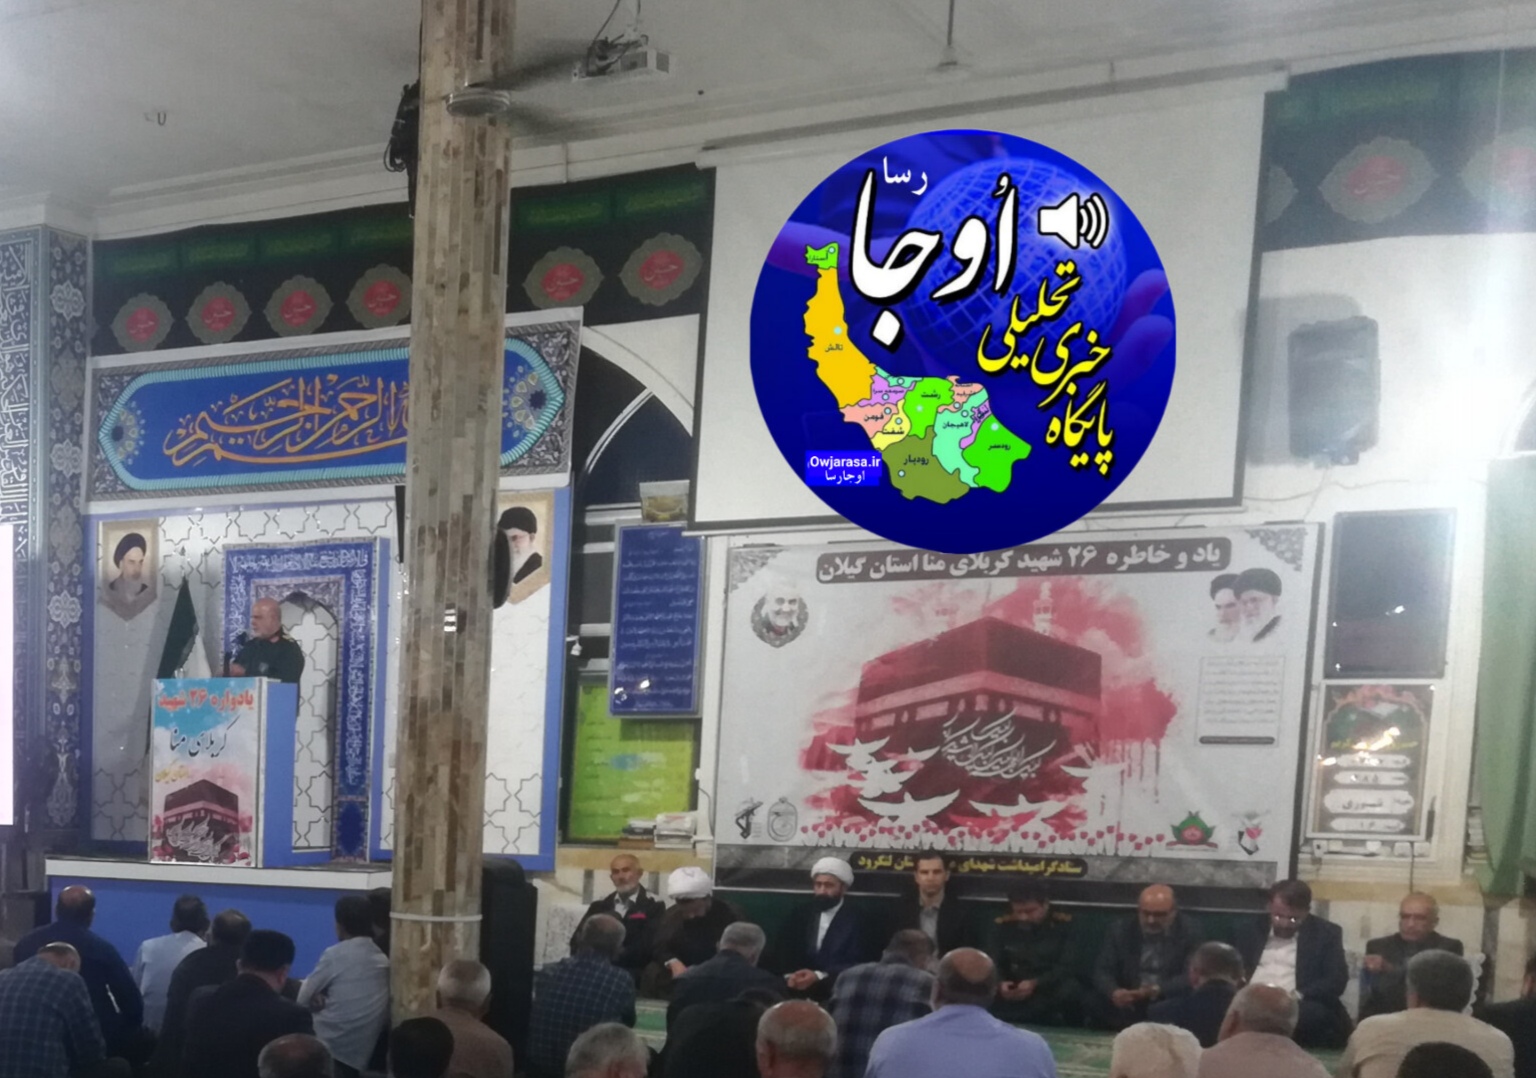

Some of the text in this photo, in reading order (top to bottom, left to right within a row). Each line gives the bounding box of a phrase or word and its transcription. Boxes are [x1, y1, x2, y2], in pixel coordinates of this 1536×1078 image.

[868, 553, 919, 580] استان
[922, 553, 946, 572] منا
[949, 550, 1014, 577] کربلای
[1017, 547, 1064, 574] شهید
[1067, 544, 1098, 568] ۲۶
[1106, 543, 1172, 571] خاطره
[1174, 551, 1188, 570] و
[1192, 541, 1221, 567] یاد
[157, 688, 255, 713] یادواره ۲۶ شهید
[169, 715, 241, 758] کربلای منا
